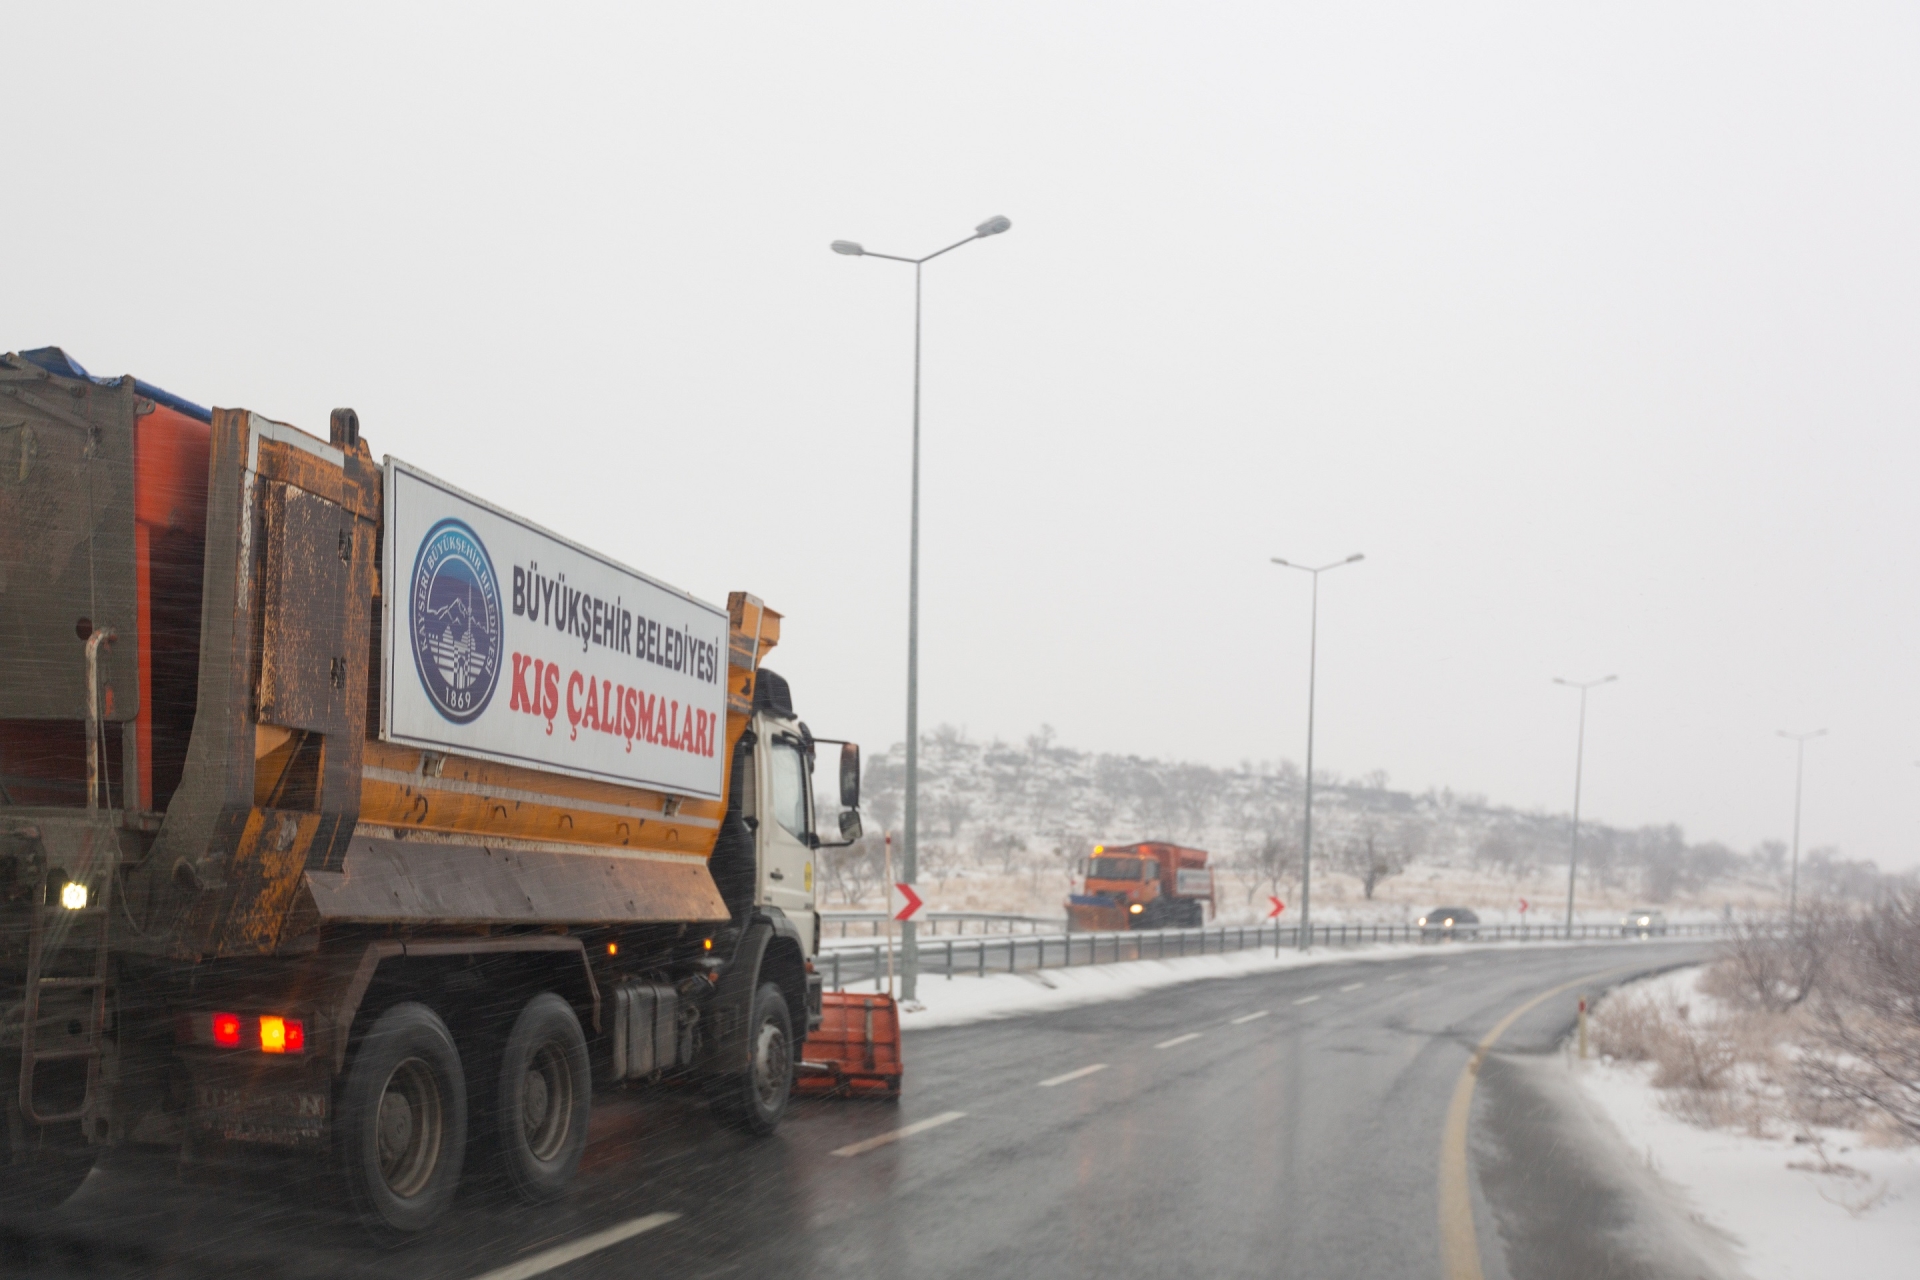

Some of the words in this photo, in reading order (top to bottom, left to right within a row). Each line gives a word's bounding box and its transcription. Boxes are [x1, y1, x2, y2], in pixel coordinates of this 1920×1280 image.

[418, 567, 430, 653] KAYSERİ
[427, 533, 481, 571] BÜYÜKŞEHİR
[481, 571, 499, 677] BELEDİYESİ
[512, 560, 631, 655] BÜYÜKŞEHİR
[636, 615, 719, 685] BELEDİYESİ
[445, 687, 472, 709] 1869
[509, 652, 559, 735] KIŞ
[566, 669, 717, 758] ÇALIŞMALARI
